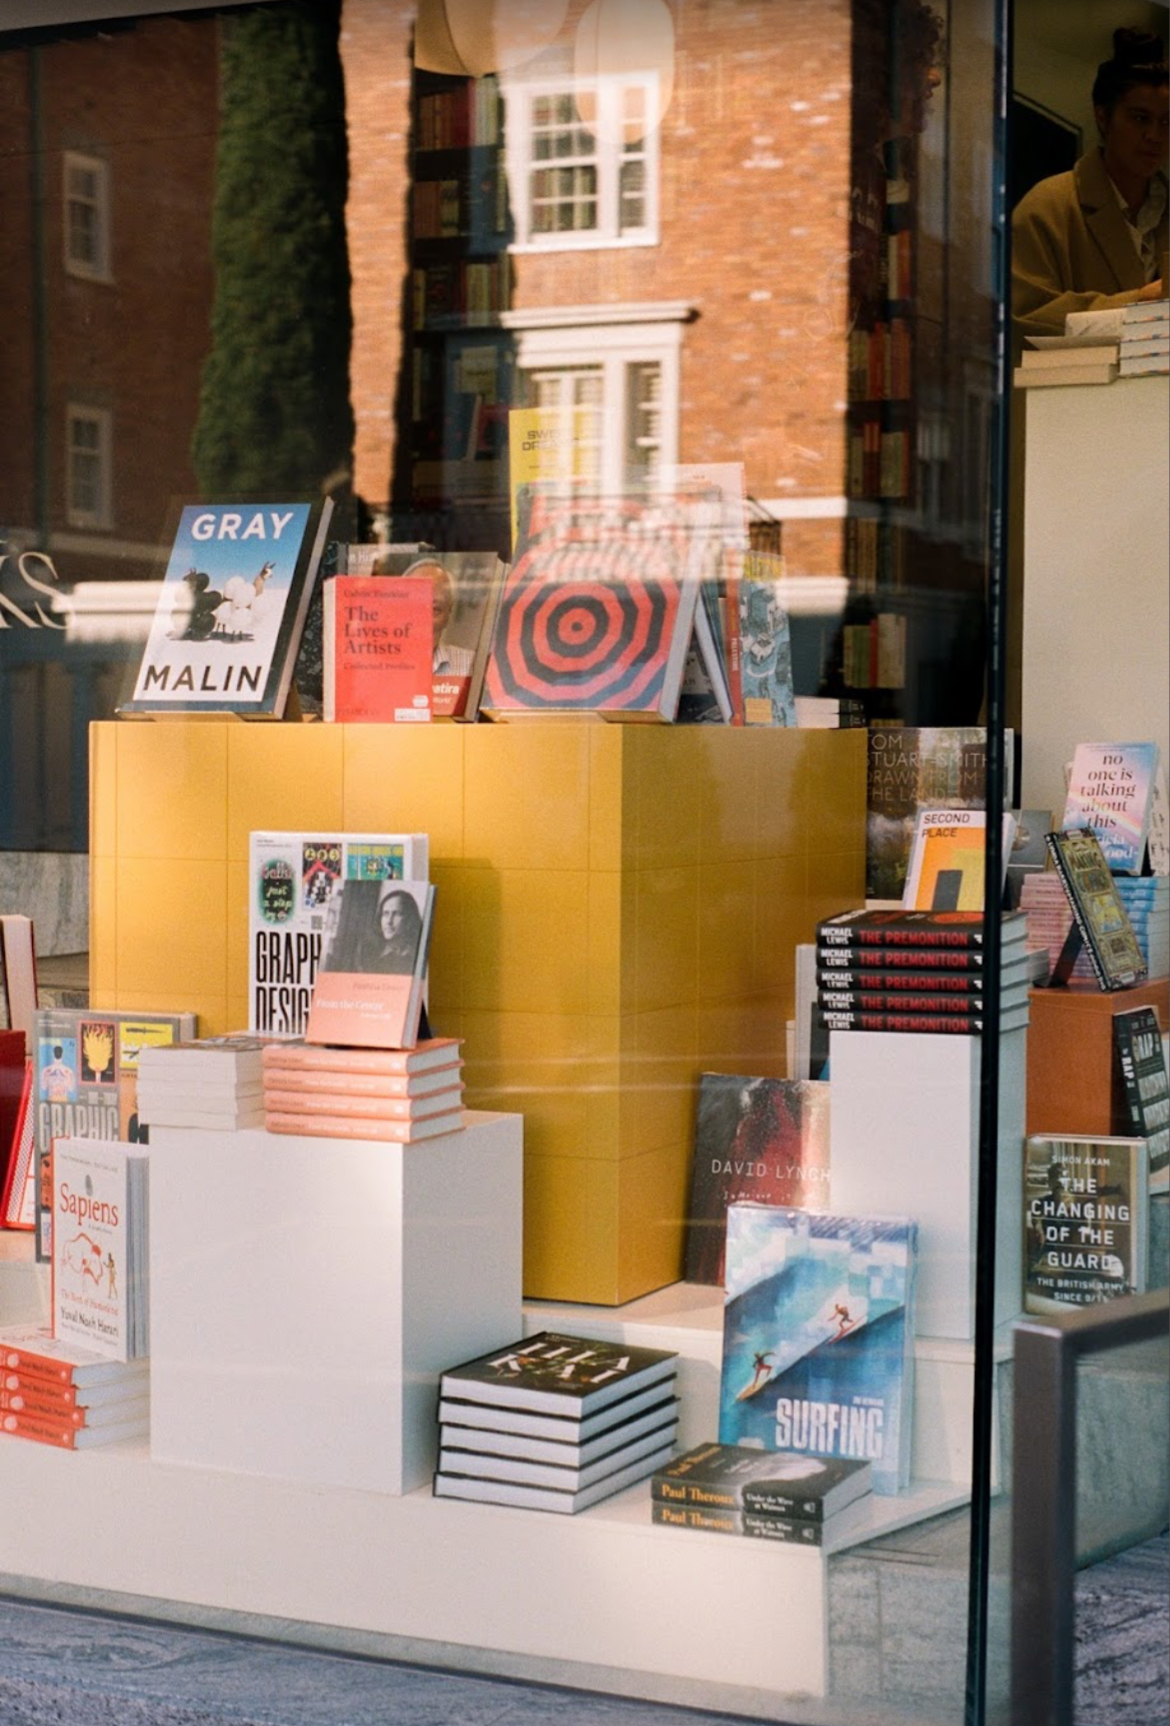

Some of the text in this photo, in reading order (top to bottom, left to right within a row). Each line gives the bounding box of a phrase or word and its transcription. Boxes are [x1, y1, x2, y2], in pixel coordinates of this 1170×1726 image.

[191, 512, 293, 541] GRAY
[344, 605, 378, 621] The
[345, 622, 412, 637] Lives of
[344, 639, 401, 654] Artists
[143, 665, 262, 692] MALIN
[1103, 755, 1123, 765] no
[1088, 768, 1133, 780] one is
[1080, 783, 1136, 798] talking
[1082, 799, 1127, 812] about
[924, 813, 970, 824] SECOND
[1088, 814, 1116, 828] this
[922, 828, 958, 838] PLACE
[821, 928, 853, 937] MICHAEL
[860, 930, 968, 946] THE PREMONITION
[826, 937, 849, 945] LEWIS
[256, 931, 321, 984] GRAPH
[821, 949, 853, 958] MICHAEL
[860, 952, 968, 967] THE PREMONITION
[826, 958, 849, 966] LEWIS
[822, 973, 853, 982] MICHAEL
[860, 975, 968, 990] THE PREMONITION
[823, 993, 854, 1002] MICHAEL
[828, 1001, 850, 1009] LEWIS
[861, 996, 969, 1012] THE PREMONITION
[256, 986, 314, 1034] DESIG
[823, 1013, 854, 1022] MICHAEL
[829, 1021, 850, 1029] LEWIS
[861, 1015, 969, 1031] THE PREMONITION
[1121, 1056, 1135, 1079] RAP
[39, 1103, 119, 1152] GRAPHIC
[1052, 1155, 1110, 1166] SIMON AKAM
[711, 1159, 831, 1182] DAVID LYNCH
[1060, 1177, 1097, 1193] THE
[60, 1183, 119, 1227] Sapiens
[1031, 1200, 1130, 1221] CHANGING
[1046, 1226, 1114, 1245] OF THE
[1047, 1251, 1112, 1270] GUARD
[1037, 1278, 1053, 1287] THE
[1057, 1279, 1093, 1289] BRITISH
[1054, 1292, 1081, 1301] SINCE
[775, 1398, 884, 1459] SURFING
[661, 1485, 735, 1505] Paul Theroux
[662, 1509, 734, 1530] Paul Theroux
